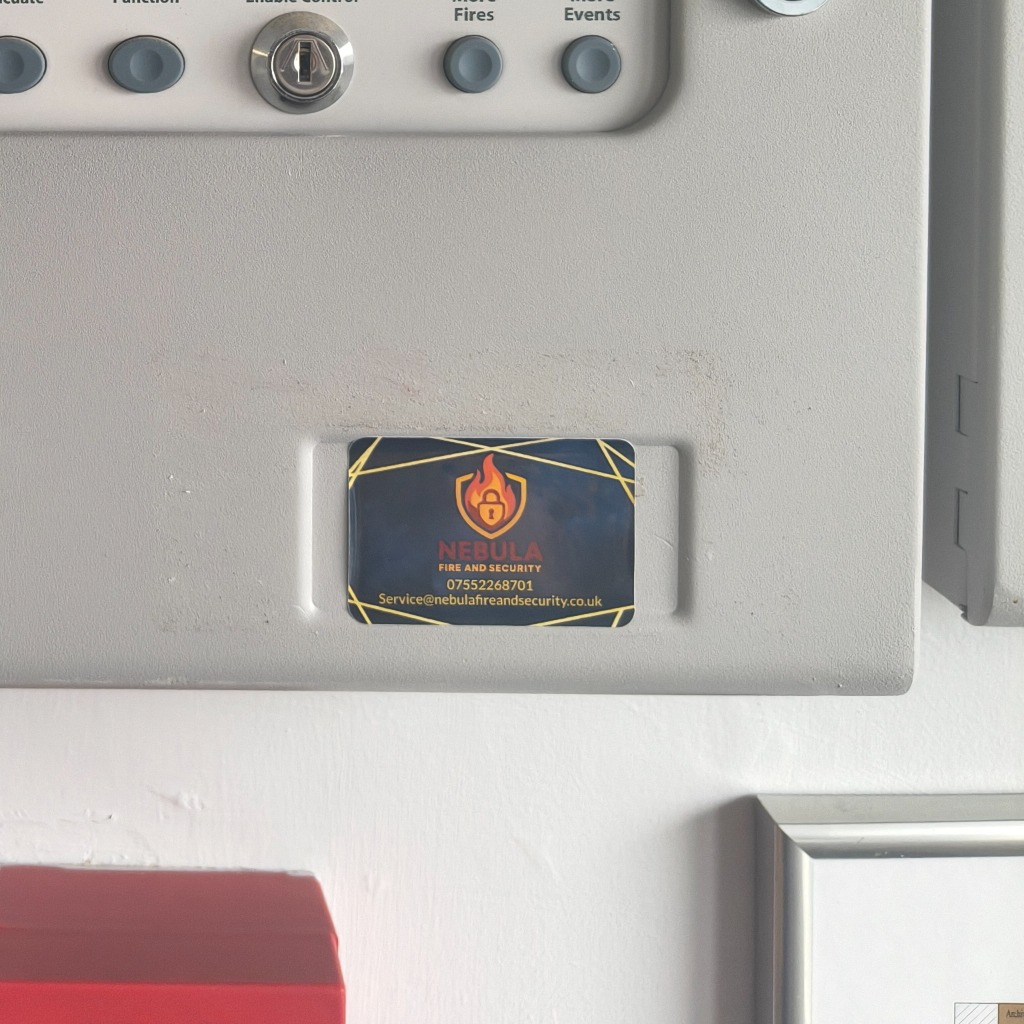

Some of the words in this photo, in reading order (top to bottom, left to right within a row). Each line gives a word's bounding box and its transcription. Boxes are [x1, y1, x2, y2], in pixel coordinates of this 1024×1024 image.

[455, 7, 494, 21] Fires
[565, 7, 620, 21] Events
[438, 540, 544, 561] NEBULA
[464, 564, 486, 572] AND
[489, 564, 541, 572] SECURITY
[447, 579, 533, 591] 07552268701
[379, 593, 602, 608] Service@nebulafireandsecurity.co.uk
